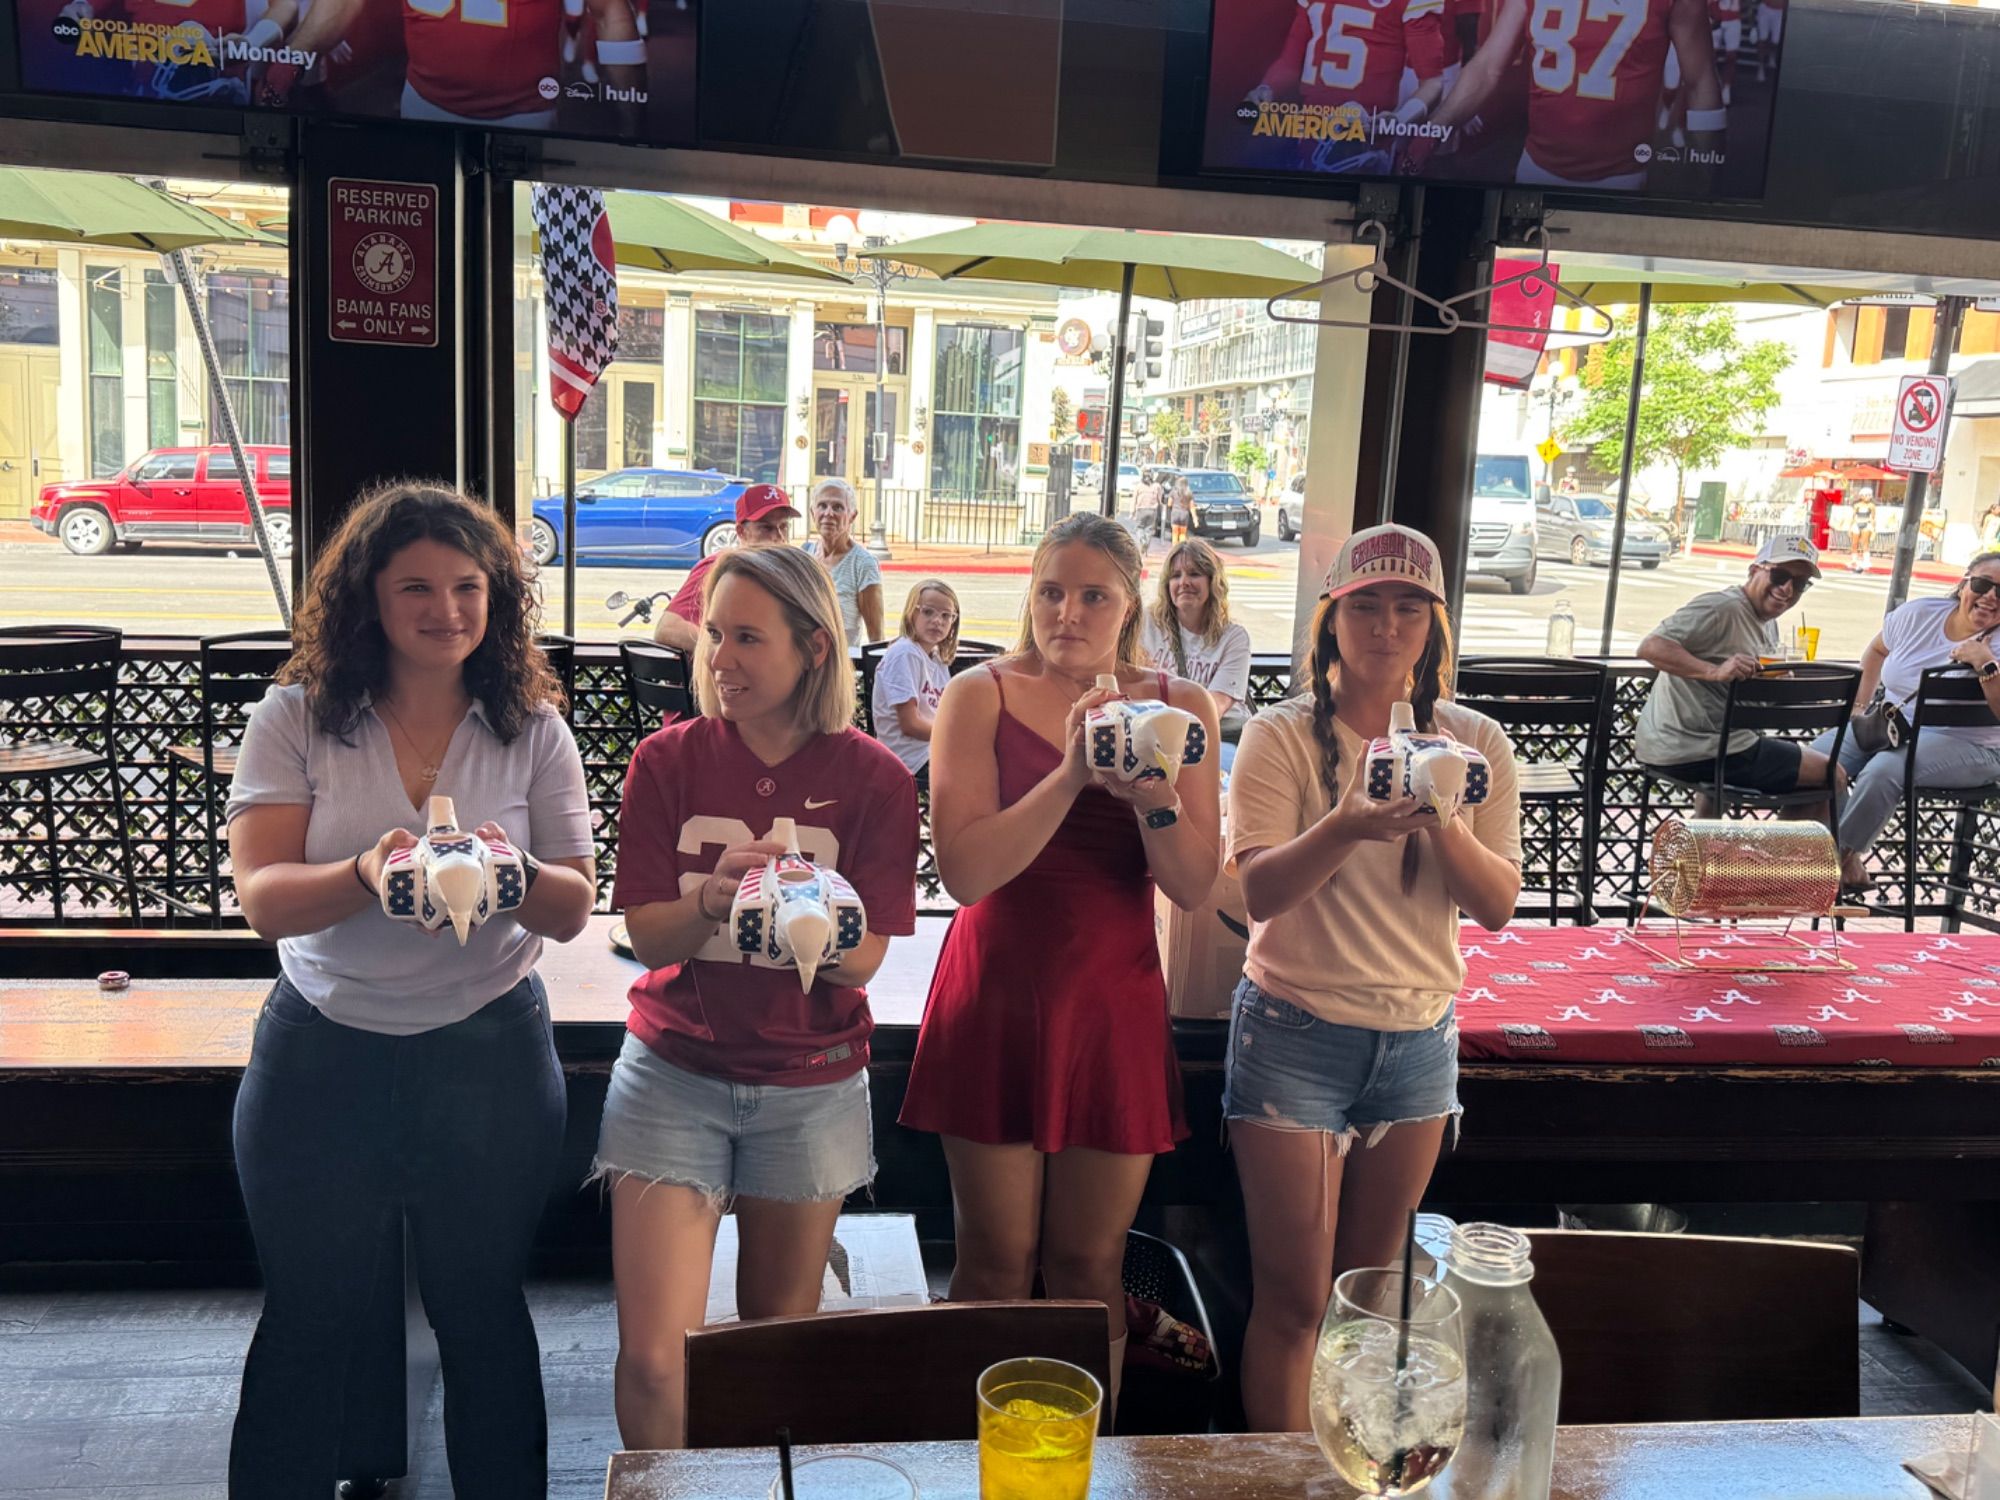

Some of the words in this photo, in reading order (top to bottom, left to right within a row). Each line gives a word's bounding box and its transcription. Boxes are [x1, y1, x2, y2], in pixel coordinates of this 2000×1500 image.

[53, 24, 79, 36] abc
[79, 18, 128, 33] GOOD
[132, 22, 204, 40] MORNING
[75, 31, 216, 68] AMERICA
[1301, 2, 1377, 90] 15
[1528, 0, 1648, 100] 87
[228, 40, 317, 70] Monday
[606, 84, 648, 103] hulu
[1236, 108, 1258, 118] abc
[1258, 101, 1299, 115] GOOD
[1303, 103, 1361, 119] MORNING
[1252, 113, 1366, 142] AMERICA
[1378, 118, 1453, 142] Monday
[1690, 149, 1725, 164] hulu
[337, 188, 430, 209] RESERVED
[344, 207, 422, 226] PARKING
[356, 234, 412, 261] ALABAMA
[370, 250, 395, 275] A
[356, 265, 393, 291] CRIMSON
[336, 298, 384, 316] BAMA
[390, 302, 431, 319] FANS
[363, 318, 405, 335] ONLY
[1892, 434, 1904, 445] NO
[1906, 435, 1937, 449] VENDING
[1903, 448, 1922, 461] ZONE
[764, 486, 780, 500] A
[1351, 532, 1407, 573] CRIMSON
[1407, 537, 1434, 581] TIDE
[1362, 558, 1425, 580] ALABAMA
[1485, 932, 1532, 945] A
[1926, 936, 1970, 950] A
[1569, 946, 1616, 960] A
[1906, 951, 1951, 963] A
[1454, 986, 1506, 1003] A
[1584, 988, 1636, 1004] A
[1710, 989, 1761, 1005] A
[1832, 988, 1882, 1003] A
[1950, 990, 2000, 1006] A
[1546, 1005, 1601, 1021] A
[1679, 1006, 1733, 1022] A
[1807, 1005, 1859, 1021] A
[1929, 1006, 1982, 1022] A
